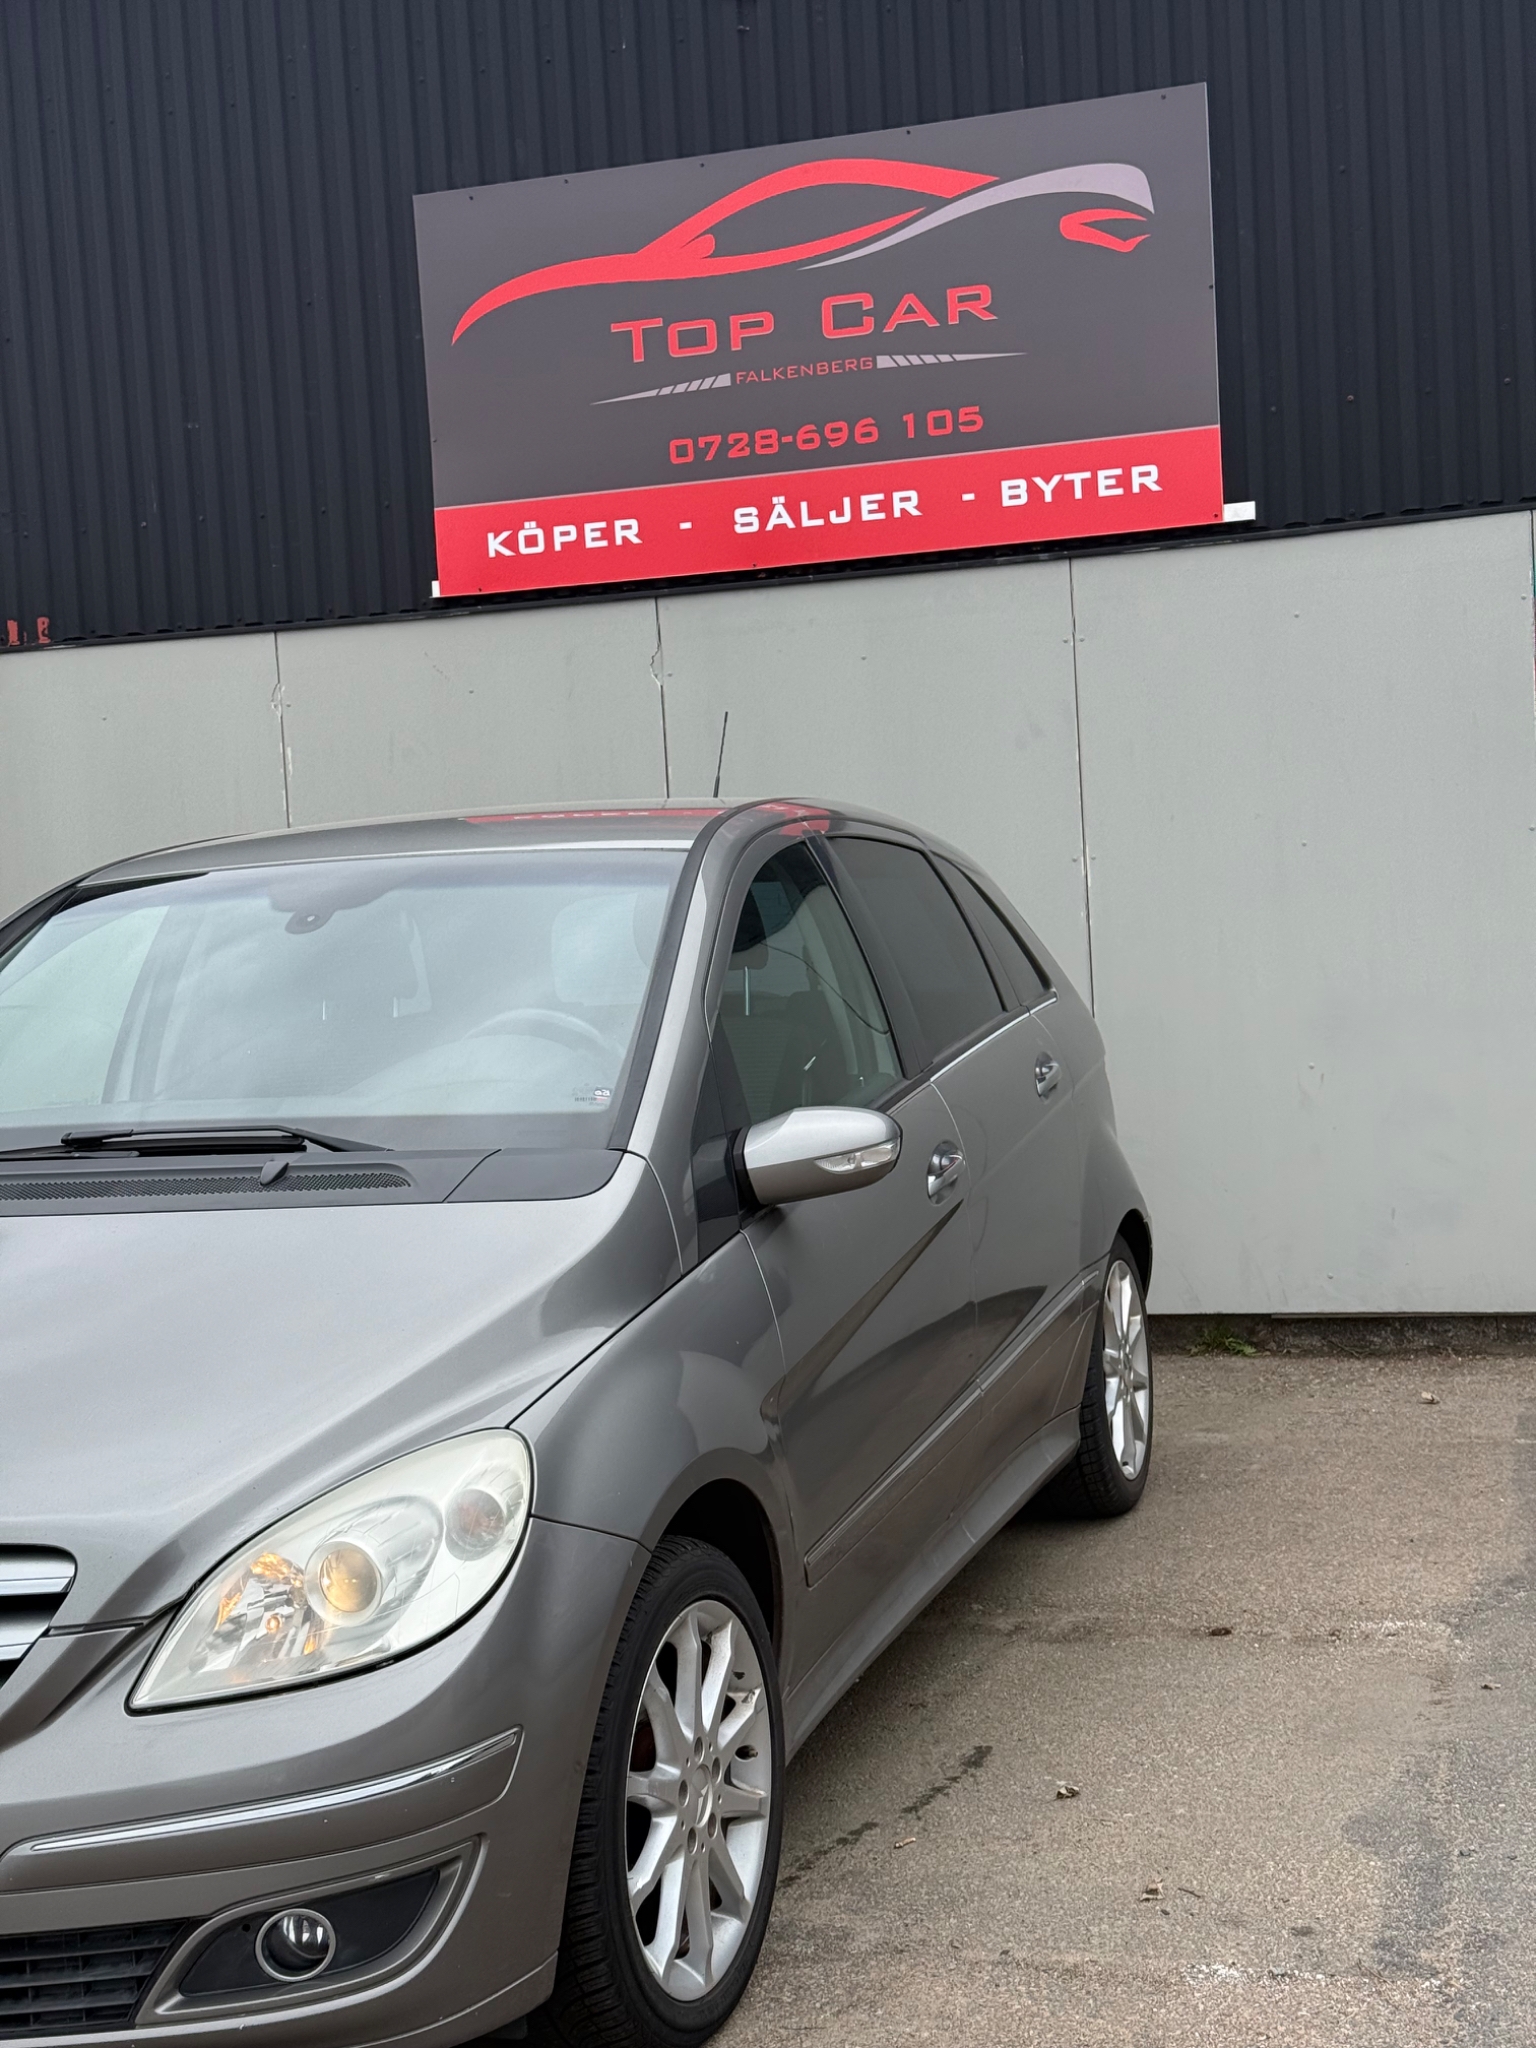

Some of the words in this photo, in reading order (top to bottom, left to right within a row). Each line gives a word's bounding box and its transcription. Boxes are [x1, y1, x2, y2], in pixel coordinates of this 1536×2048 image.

[611, 311, 775, 363] TOP
[821, 284, 999, 339] CAR
[735, 355, 875, 385] FALKENBERG
[668, 417, 880, 466] 0728-696
[902, 405, 985, 439] 105
[487, 518, 643, 559] KÖPER
[734, 489, 923, 534] SÄLJER
[1001, 464, 1163, 508] BYTER
